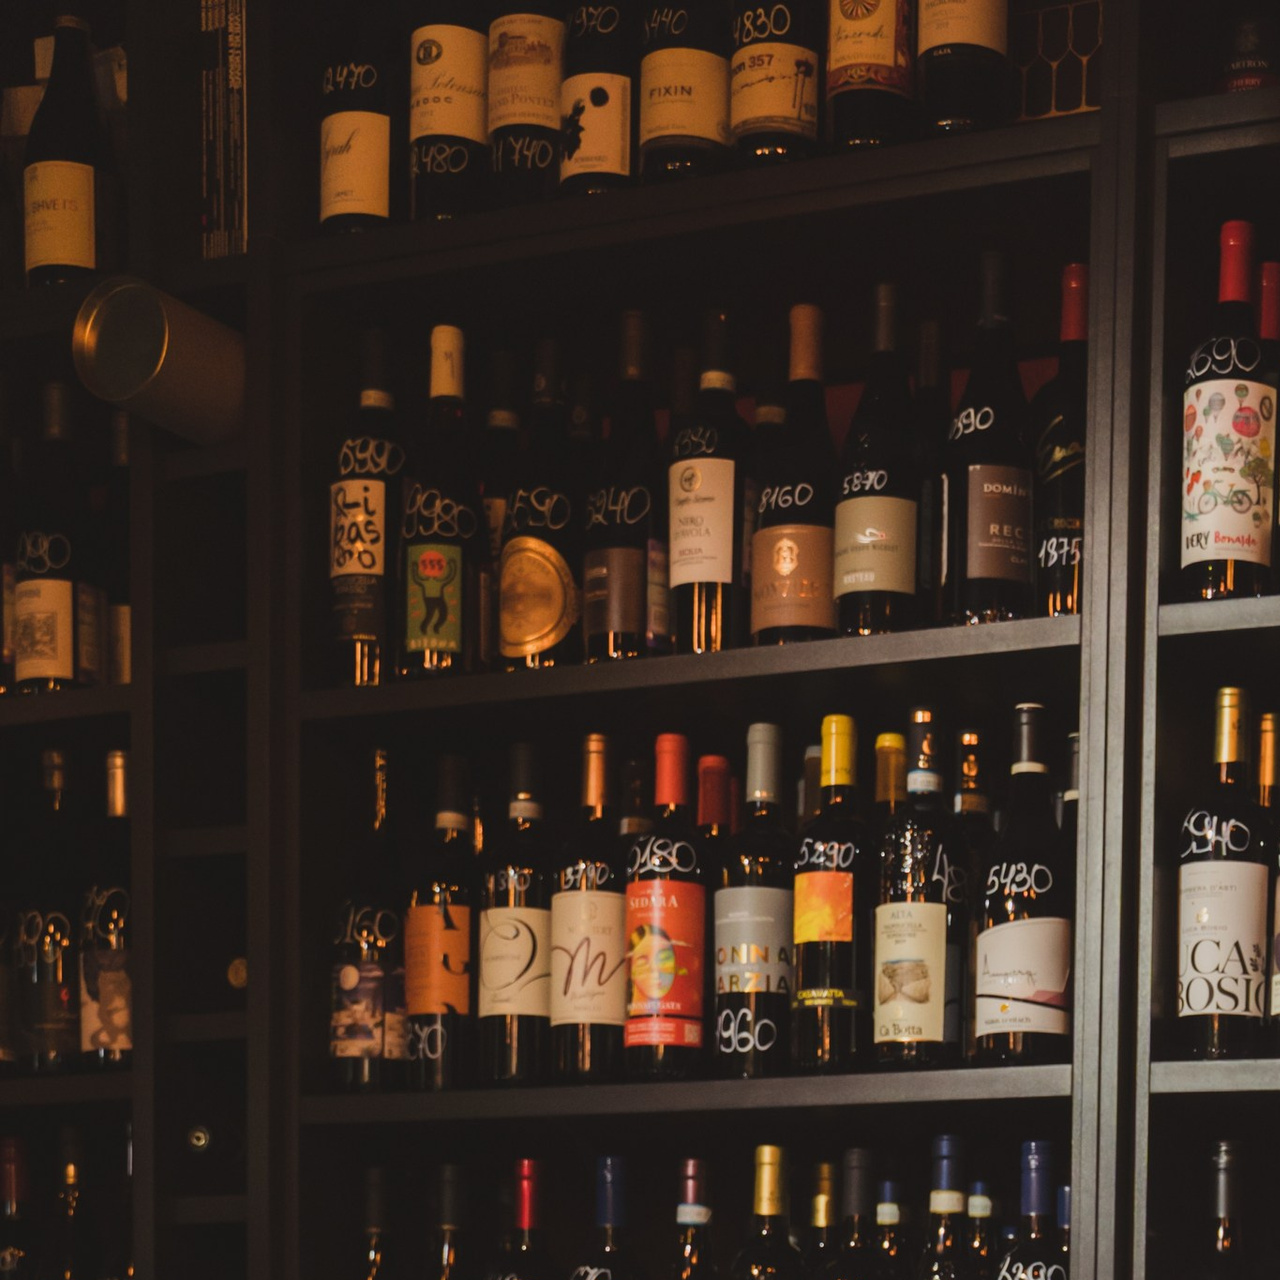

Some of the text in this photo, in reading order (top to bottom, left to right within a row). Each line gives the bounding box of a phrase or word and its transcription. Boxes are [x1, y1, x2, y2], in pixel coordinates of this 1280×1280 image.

[749, 54, 774, 70] 357
[649, 85, 692, 99] FIXIN
[758, 482, 814, 514] 8160
[1038, 536, 1082, 568] 1875
[986, 861, 1053, 896] 5430
